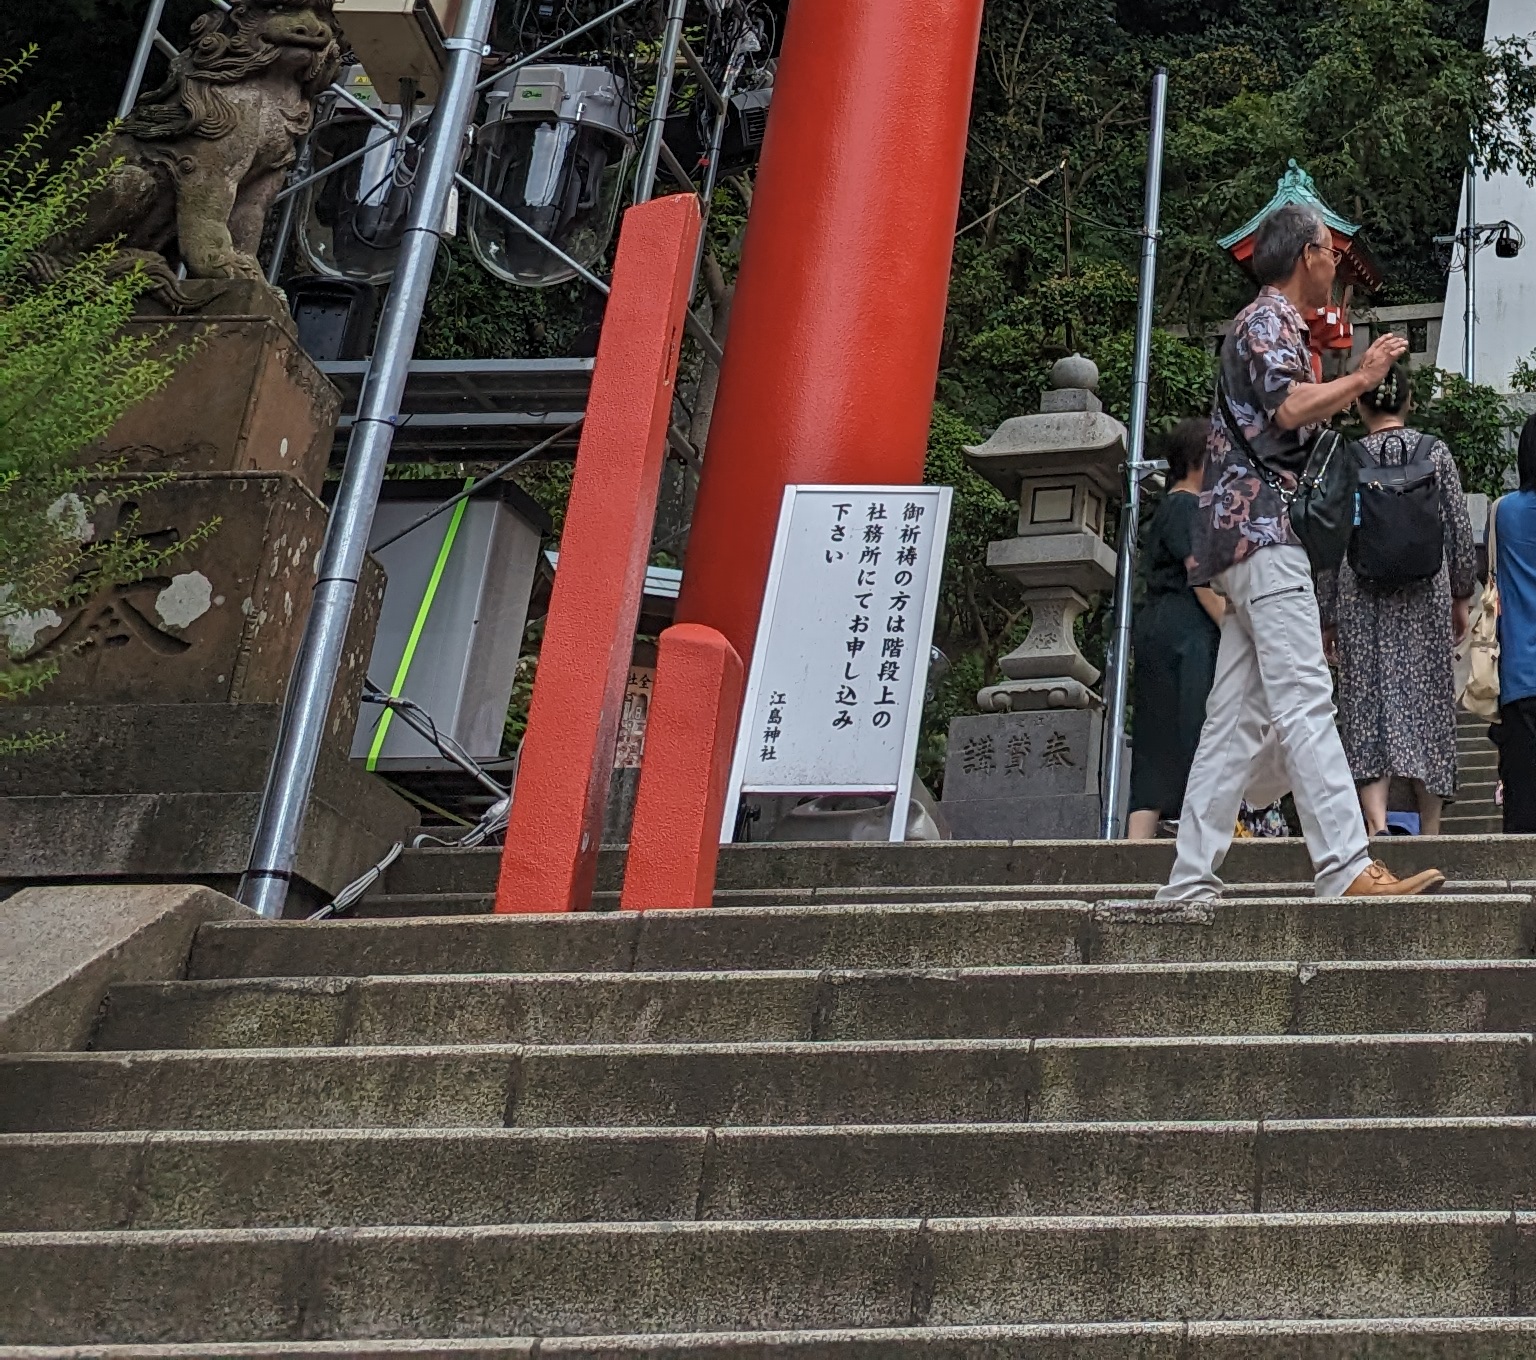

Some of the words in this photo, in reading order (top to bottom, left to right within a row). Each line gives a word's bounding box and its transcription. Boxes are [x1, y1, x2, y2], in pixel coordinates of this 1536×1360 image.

[825, 503, 853, 564] 下さい
[832, 502, 888, 731] 社務所にてお申し込み
[872, 502, 925, 729] 御祈祷の方は階段上の
[760, 690, 787, 762] 江島神社
